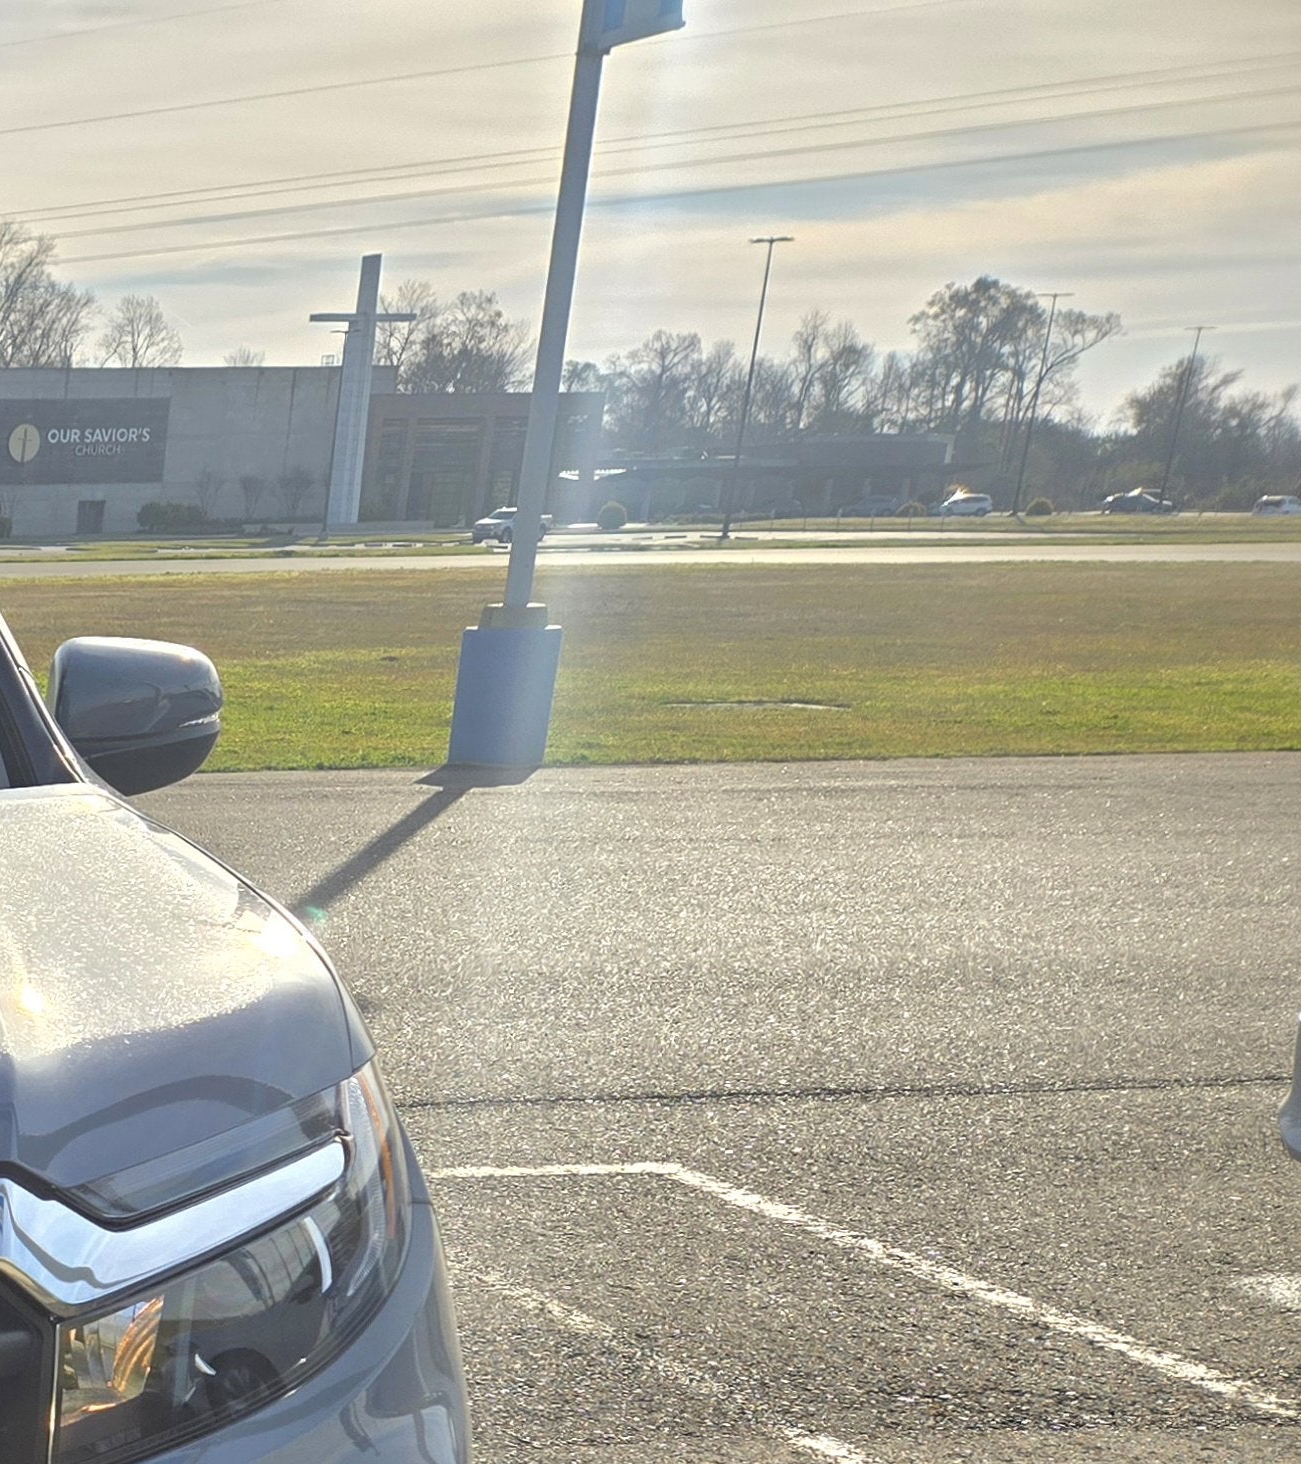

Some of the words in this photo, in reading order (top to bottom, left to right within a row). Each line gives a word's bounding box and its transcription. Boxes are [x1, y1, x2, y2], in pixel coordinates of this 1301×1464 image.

[48, 429, 80, 443] OUR
[85, 428, 151, 443] SAVIOR'S
[75, 444, 121, 456] CHURCH
